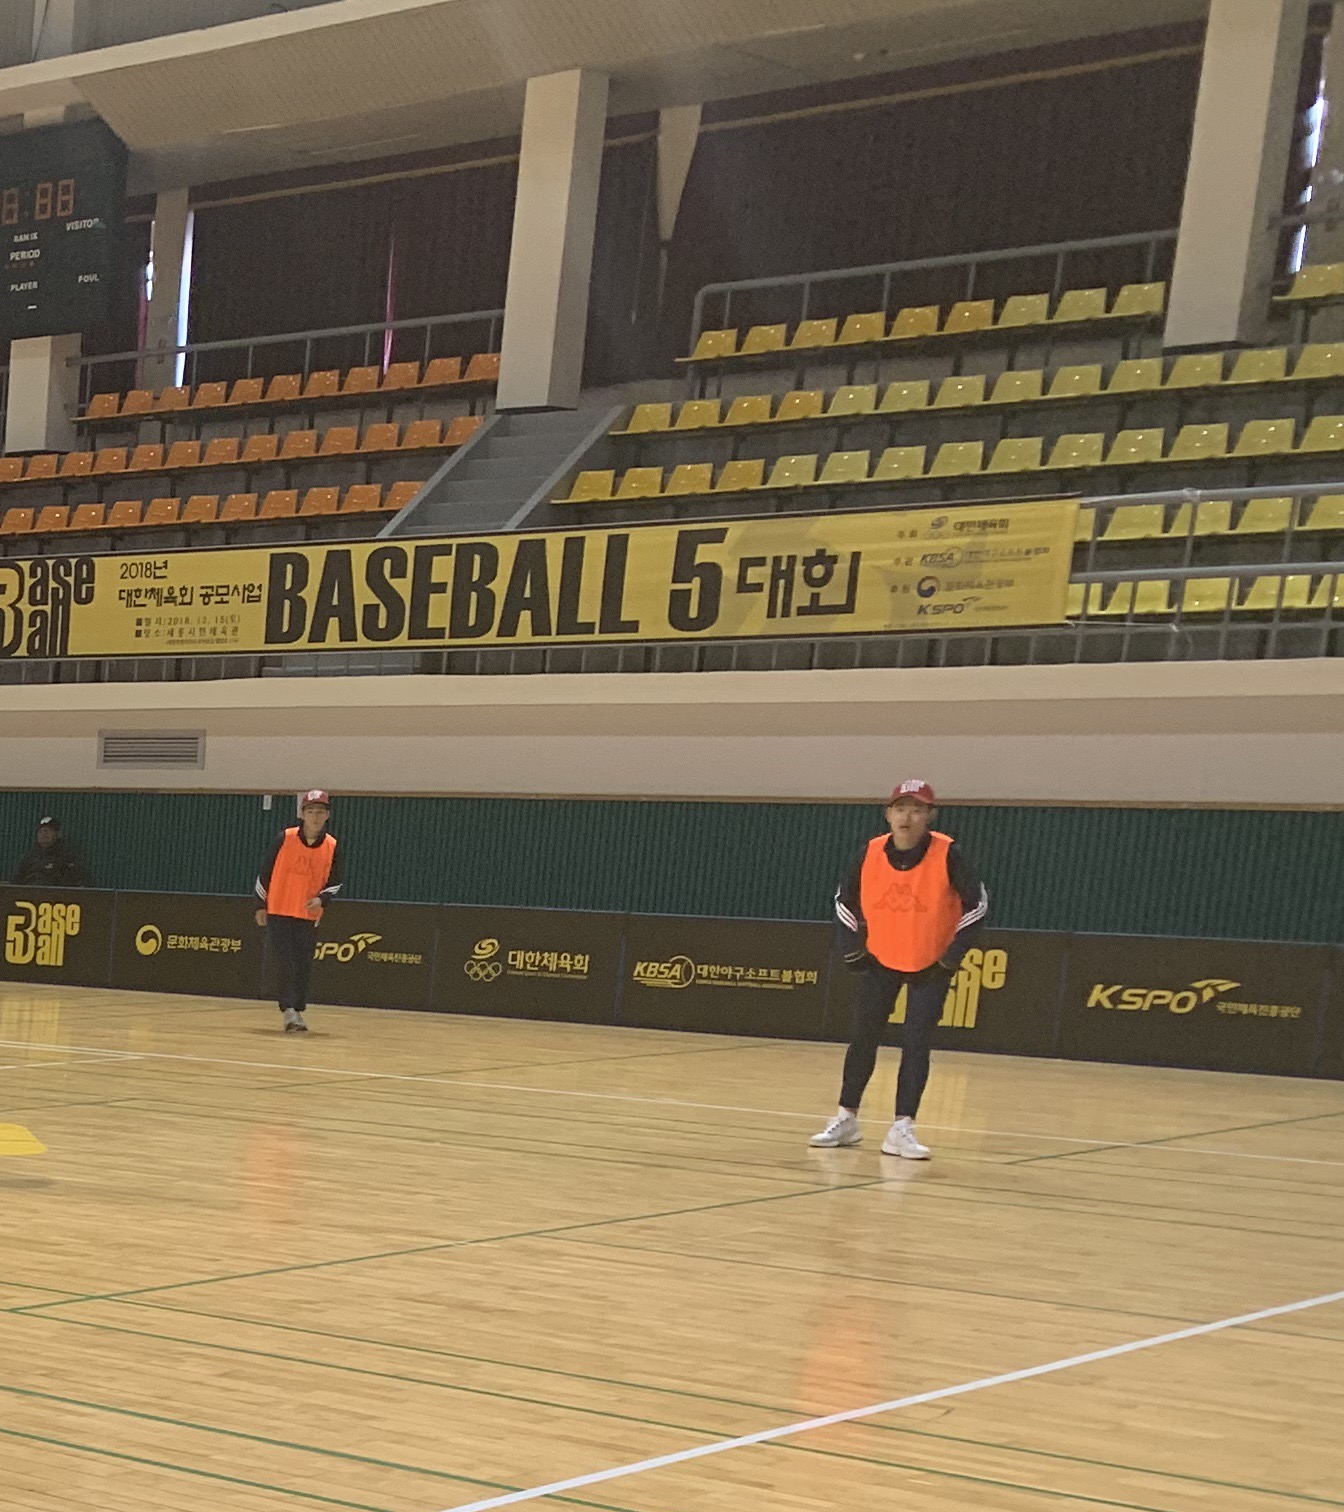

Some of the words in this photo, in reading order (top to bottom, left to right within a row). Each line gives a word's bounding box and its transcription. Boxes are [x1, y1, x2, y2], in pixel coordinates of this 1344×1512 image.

[9, 249, 41, 261] PERIOD
[10, 281, 38, 292] PLAYER
[119, 560, 168, 580] 2018년
[118, 585, 194, 608] 대한체육회
[199, 583, 262, 605] 공모사업
[263, 533, 640, 645] BASEBALL
[166, 934, 242, 953] 문화체육관광부
[507, 949, 591, 974] 대한체육회
[633, 961, 683, 980] KBSA
[696, 964, 818, 985] 대한야구소프트볼협회
[1086, 983, 1198, 1015] KSPO
